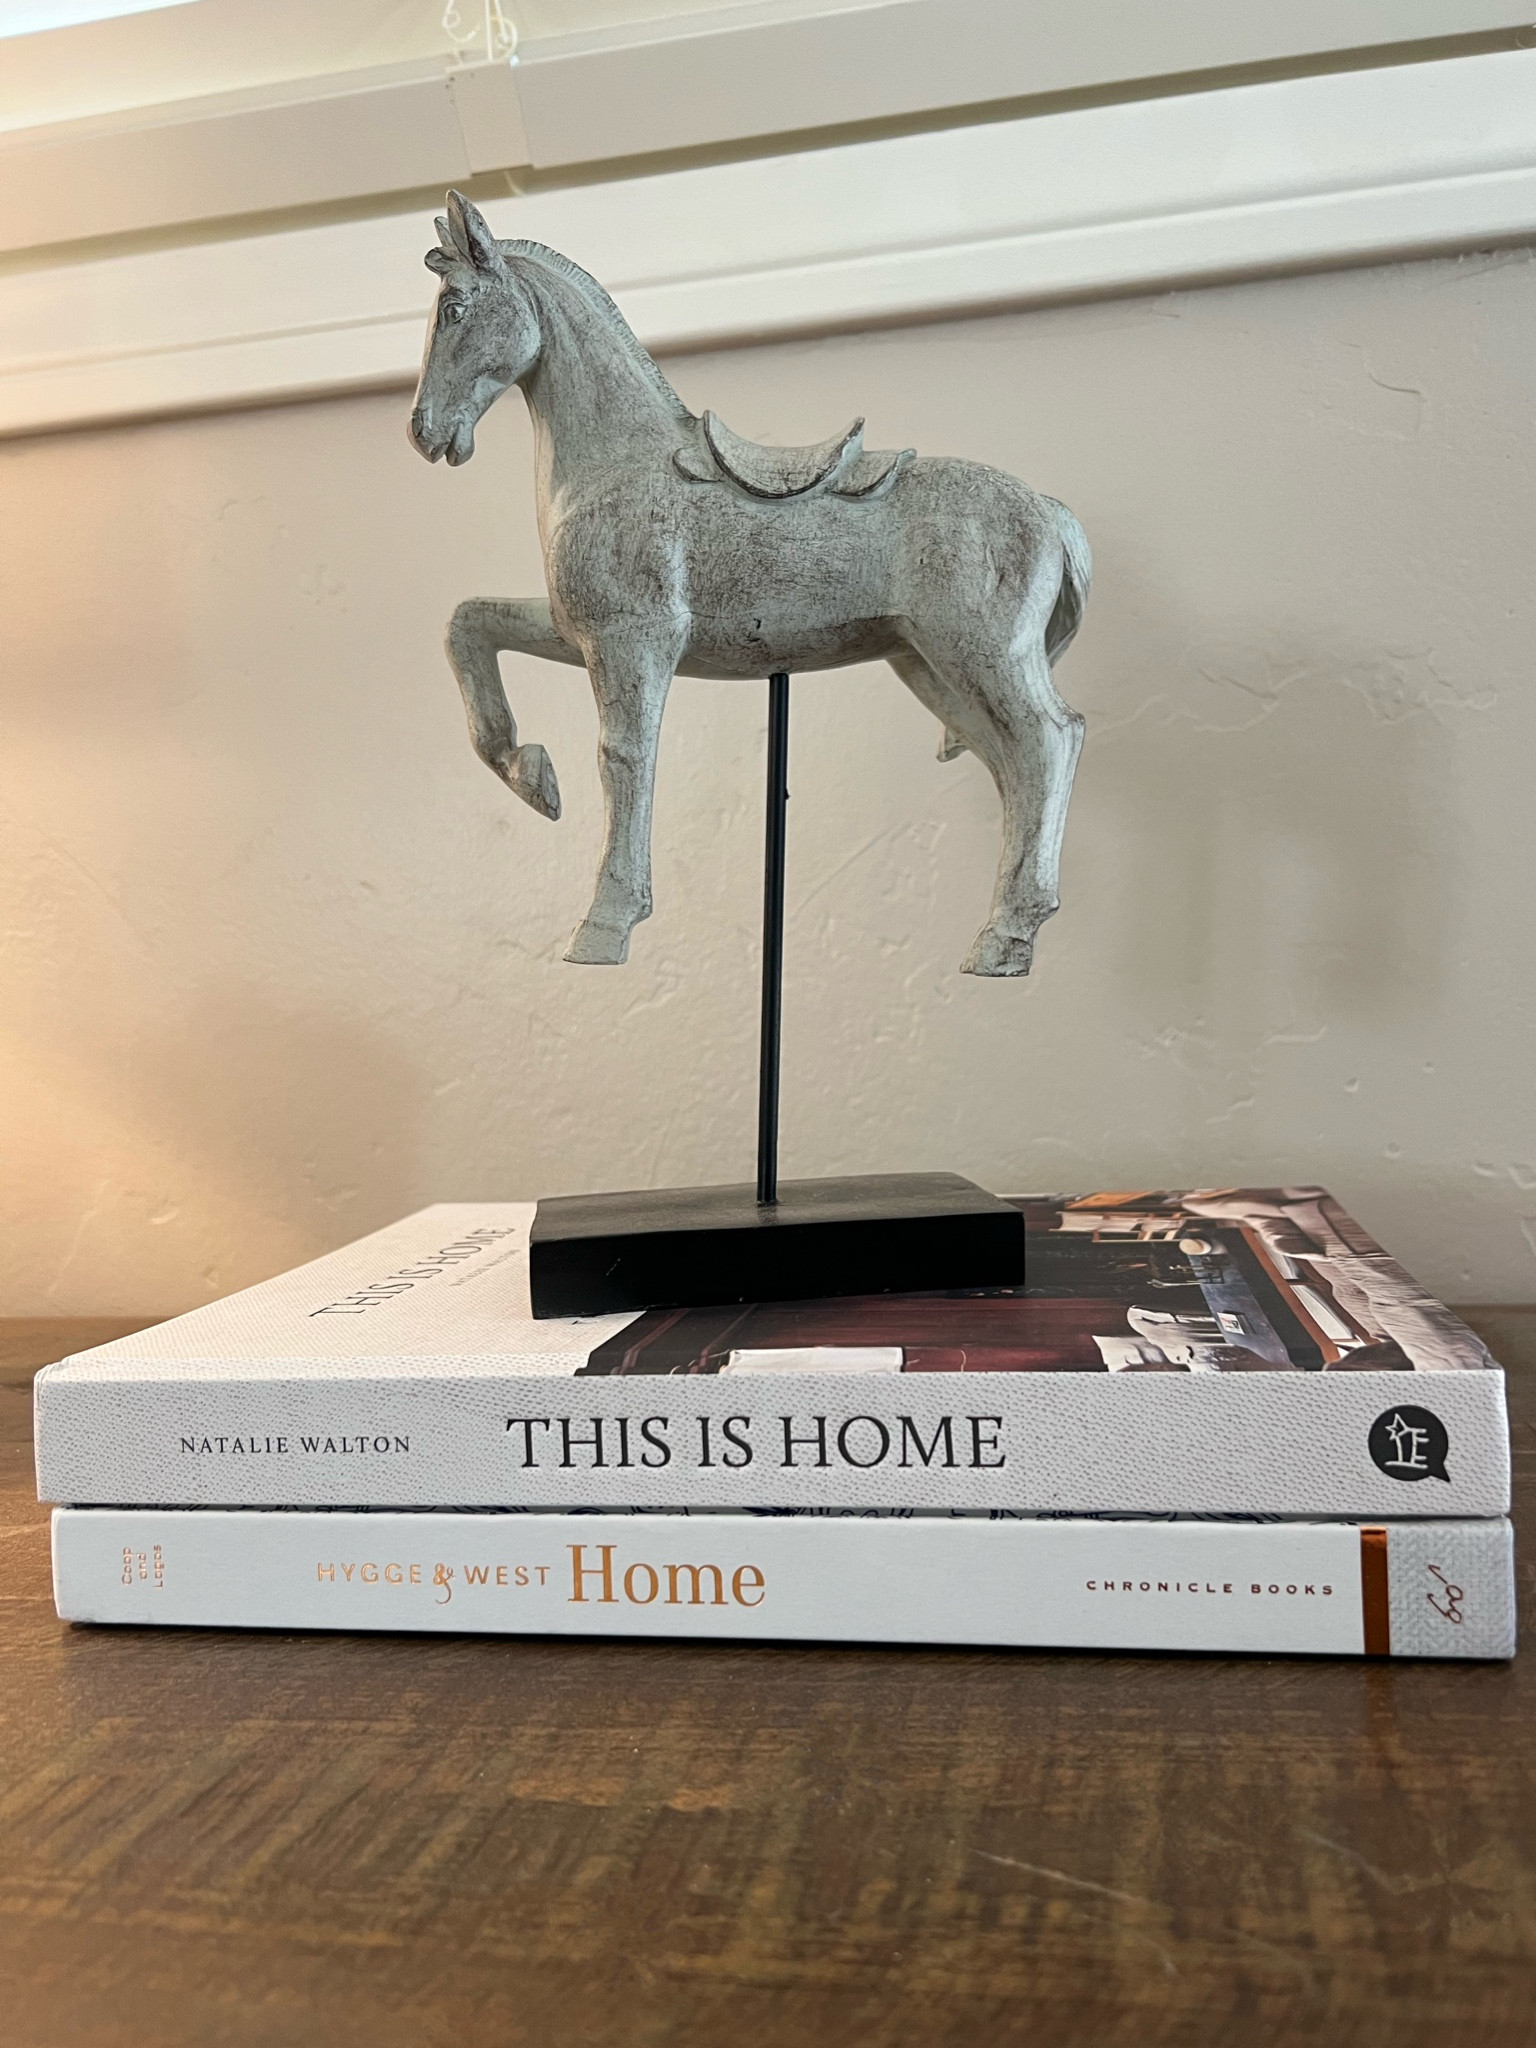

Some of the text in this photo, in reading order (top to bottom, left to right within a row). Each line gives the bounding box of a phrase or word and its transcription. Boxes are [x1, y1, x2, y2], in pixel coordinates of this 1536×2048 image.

[307, 1227, 517, 1317] THIS IS HOME
[180, 1437, 410, 1453] NATALIE WALTON
[506, 1416, 1006, 1469] THIS IS HOME
[317, 1562, 551, 1605] HYGGE & WEST
[566, 1544, 766, 1608] Home
[1085, 1580, 1334, 1595] CHRONICLE BOOKS
